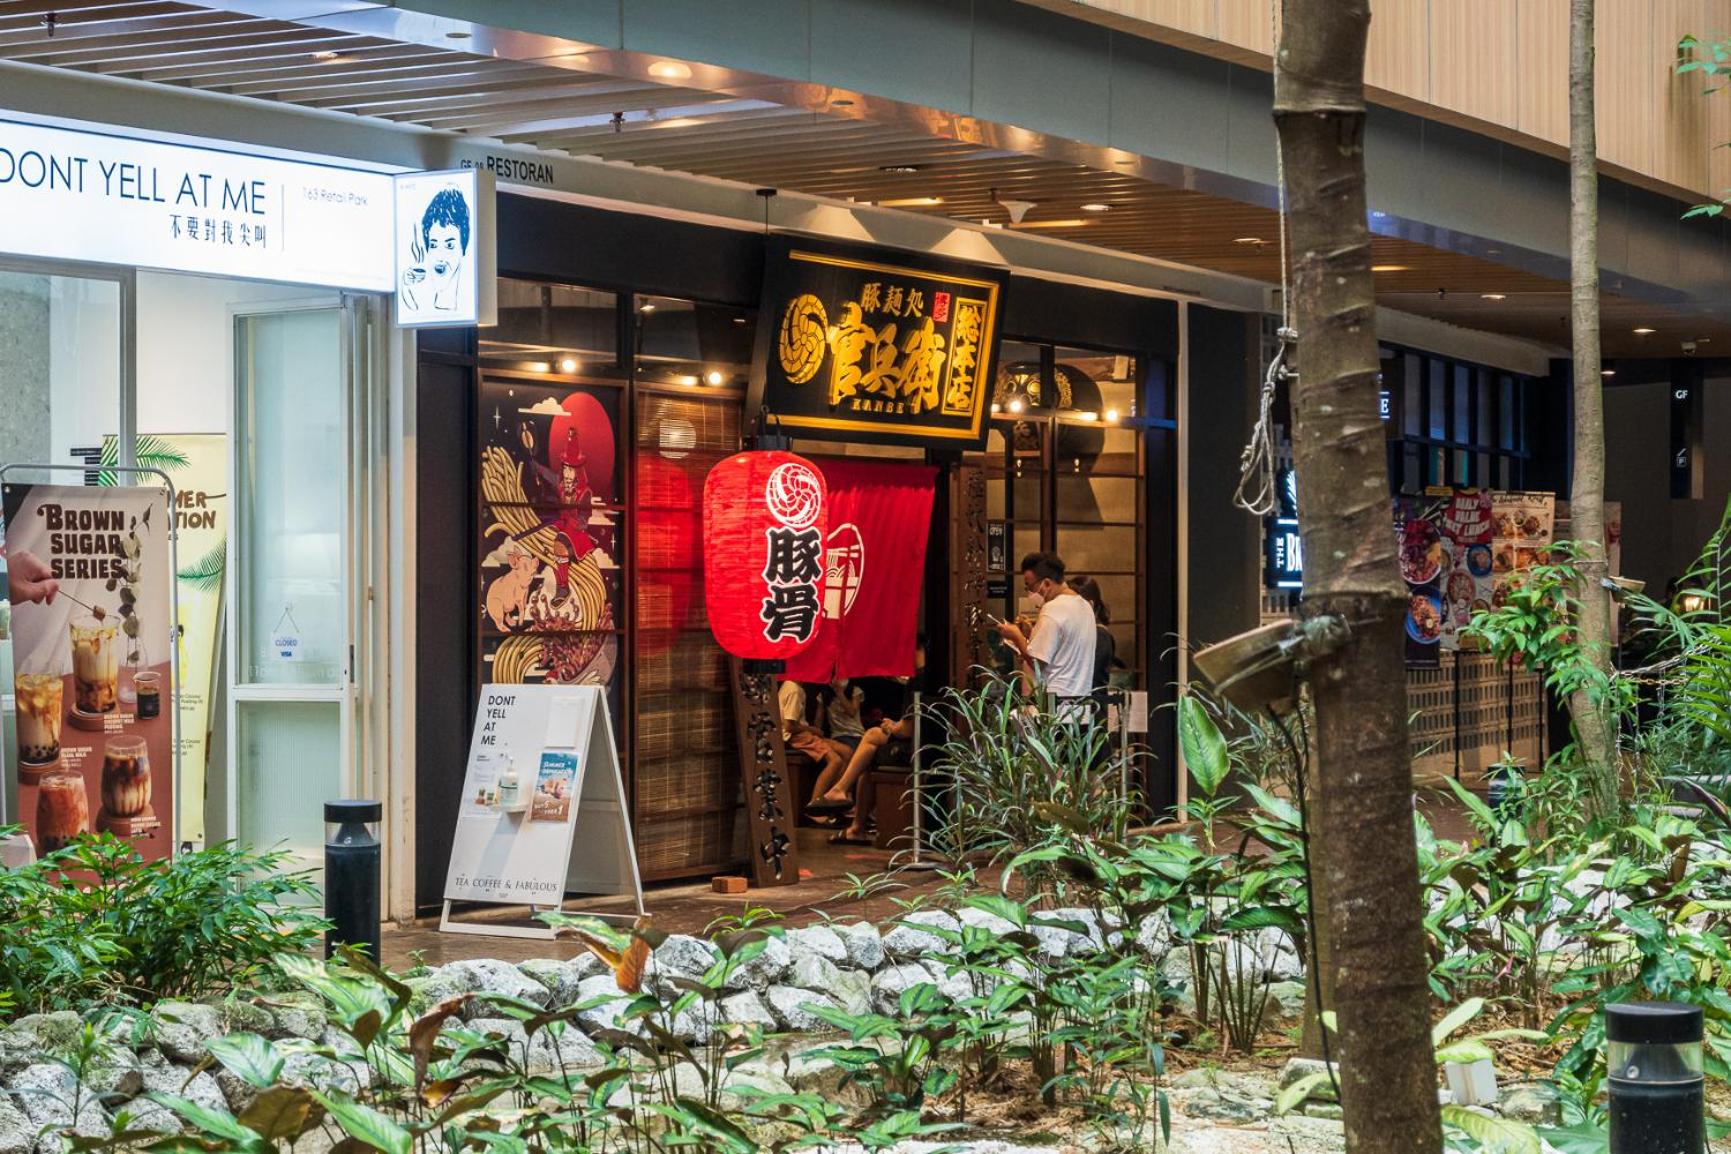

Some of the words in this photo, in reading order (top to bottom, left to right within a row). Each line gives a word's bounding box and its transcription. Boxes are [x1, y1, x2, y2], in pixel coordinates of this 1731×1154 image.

[486, 156, 554, 184] RESTORAN
[0, 147, 88, 192] DONT
[99, 160, 165, 202] YELL
[176, 173, 211, 207] AT
[222, 178, 265, 214] ME
[303, 186, 319, 200] 163
[320, 188, 346, 203] Retail
[170, 214, 266, 248] 不要對我尖叫
[1675, 389, 1688, 399] GF
[167, 490, 207, 508] MER
[36, 503, 124, 531] BROWN
[168, 511, 216, 529] TION
[50, 533, 123, 555] SUGAR
[1276, 537, 1284, 568] THE
[51, 558, 123, 579] SERIES
[761, 526, 823, 643] 豚骨
[488, 695, 516, 706] DONT
[486, 708, 506, 719] YELL
[483, 722, 496, 731] AT
[480, 735, 496, 746] ME
[455, 876, 469, 887] TEA
[472, 878, 501, 889] COFFEE
[504, 880, 512, 889] &
[515, 880, 559, 892] FABULOUS
